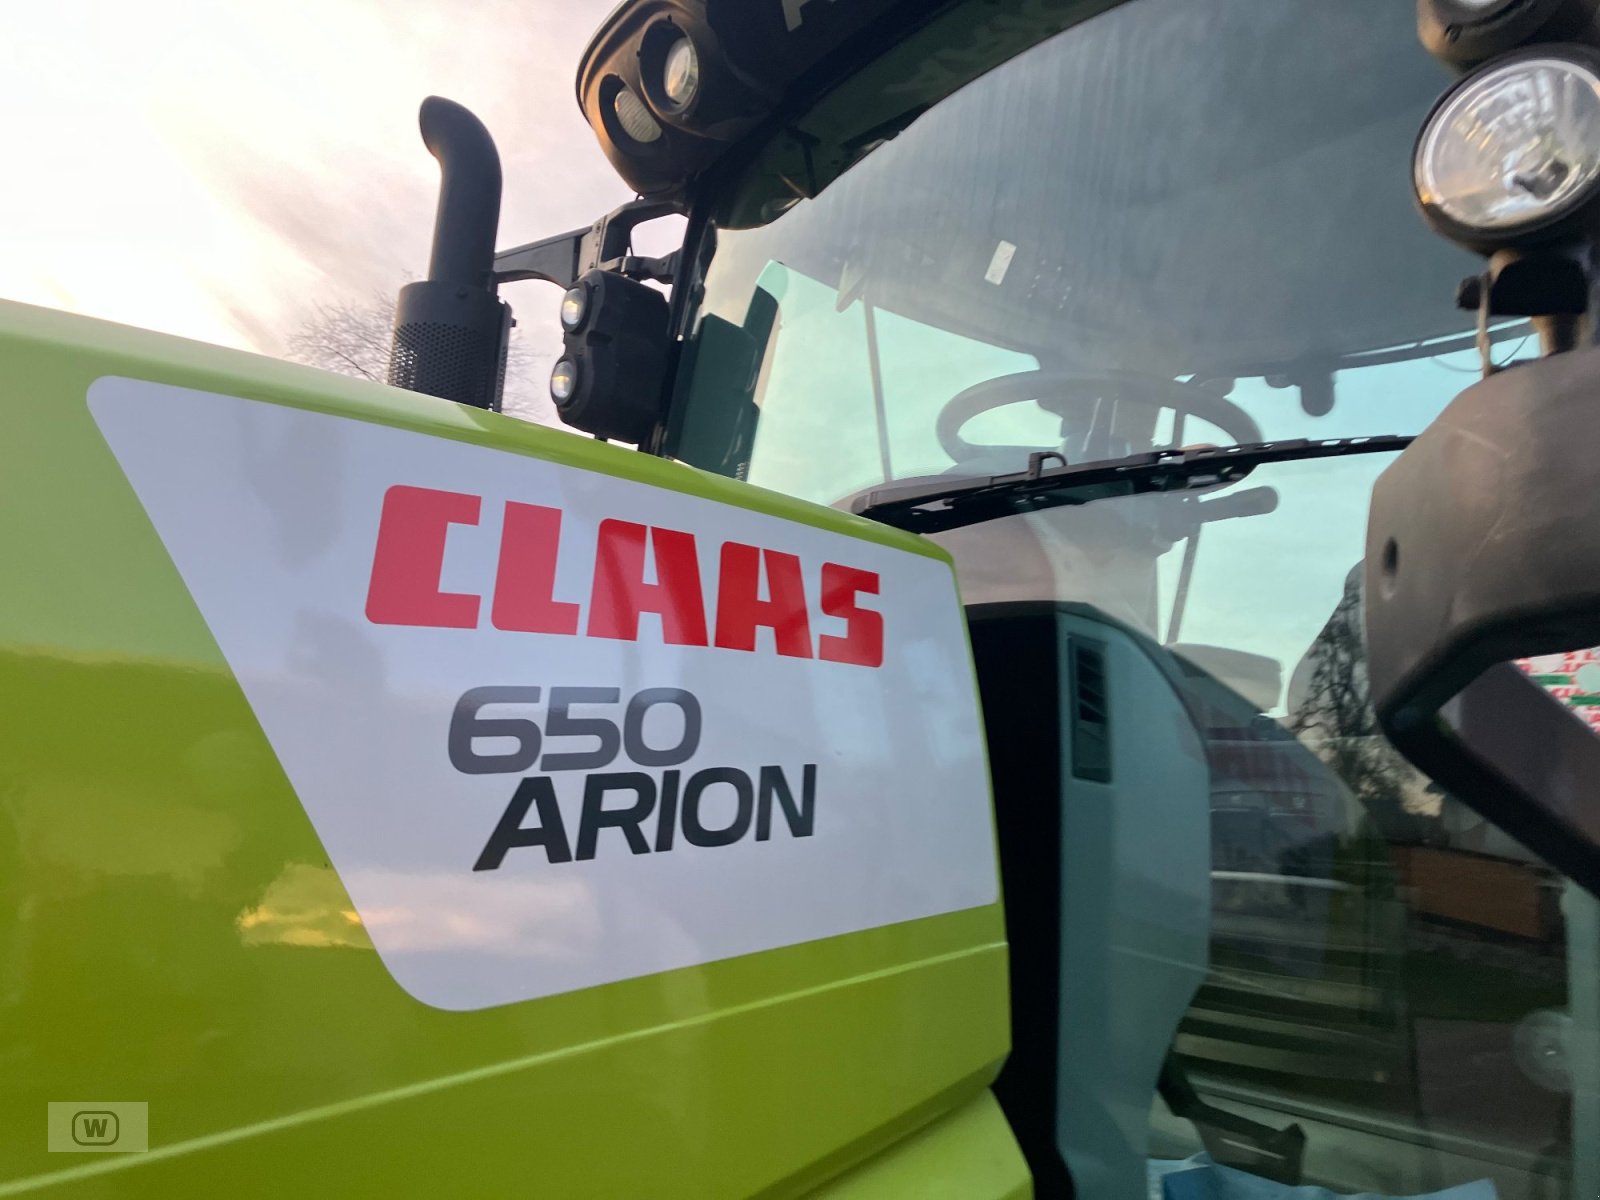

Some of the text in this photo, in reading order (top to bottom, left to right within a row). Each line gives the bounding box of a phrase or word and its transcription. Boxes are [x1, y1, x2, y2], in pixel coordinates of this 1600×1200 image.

[365, 485, 884, 667] CLAAS
[448, 685, 702, 774] 650
[472, 764, 817, 872] ARION
